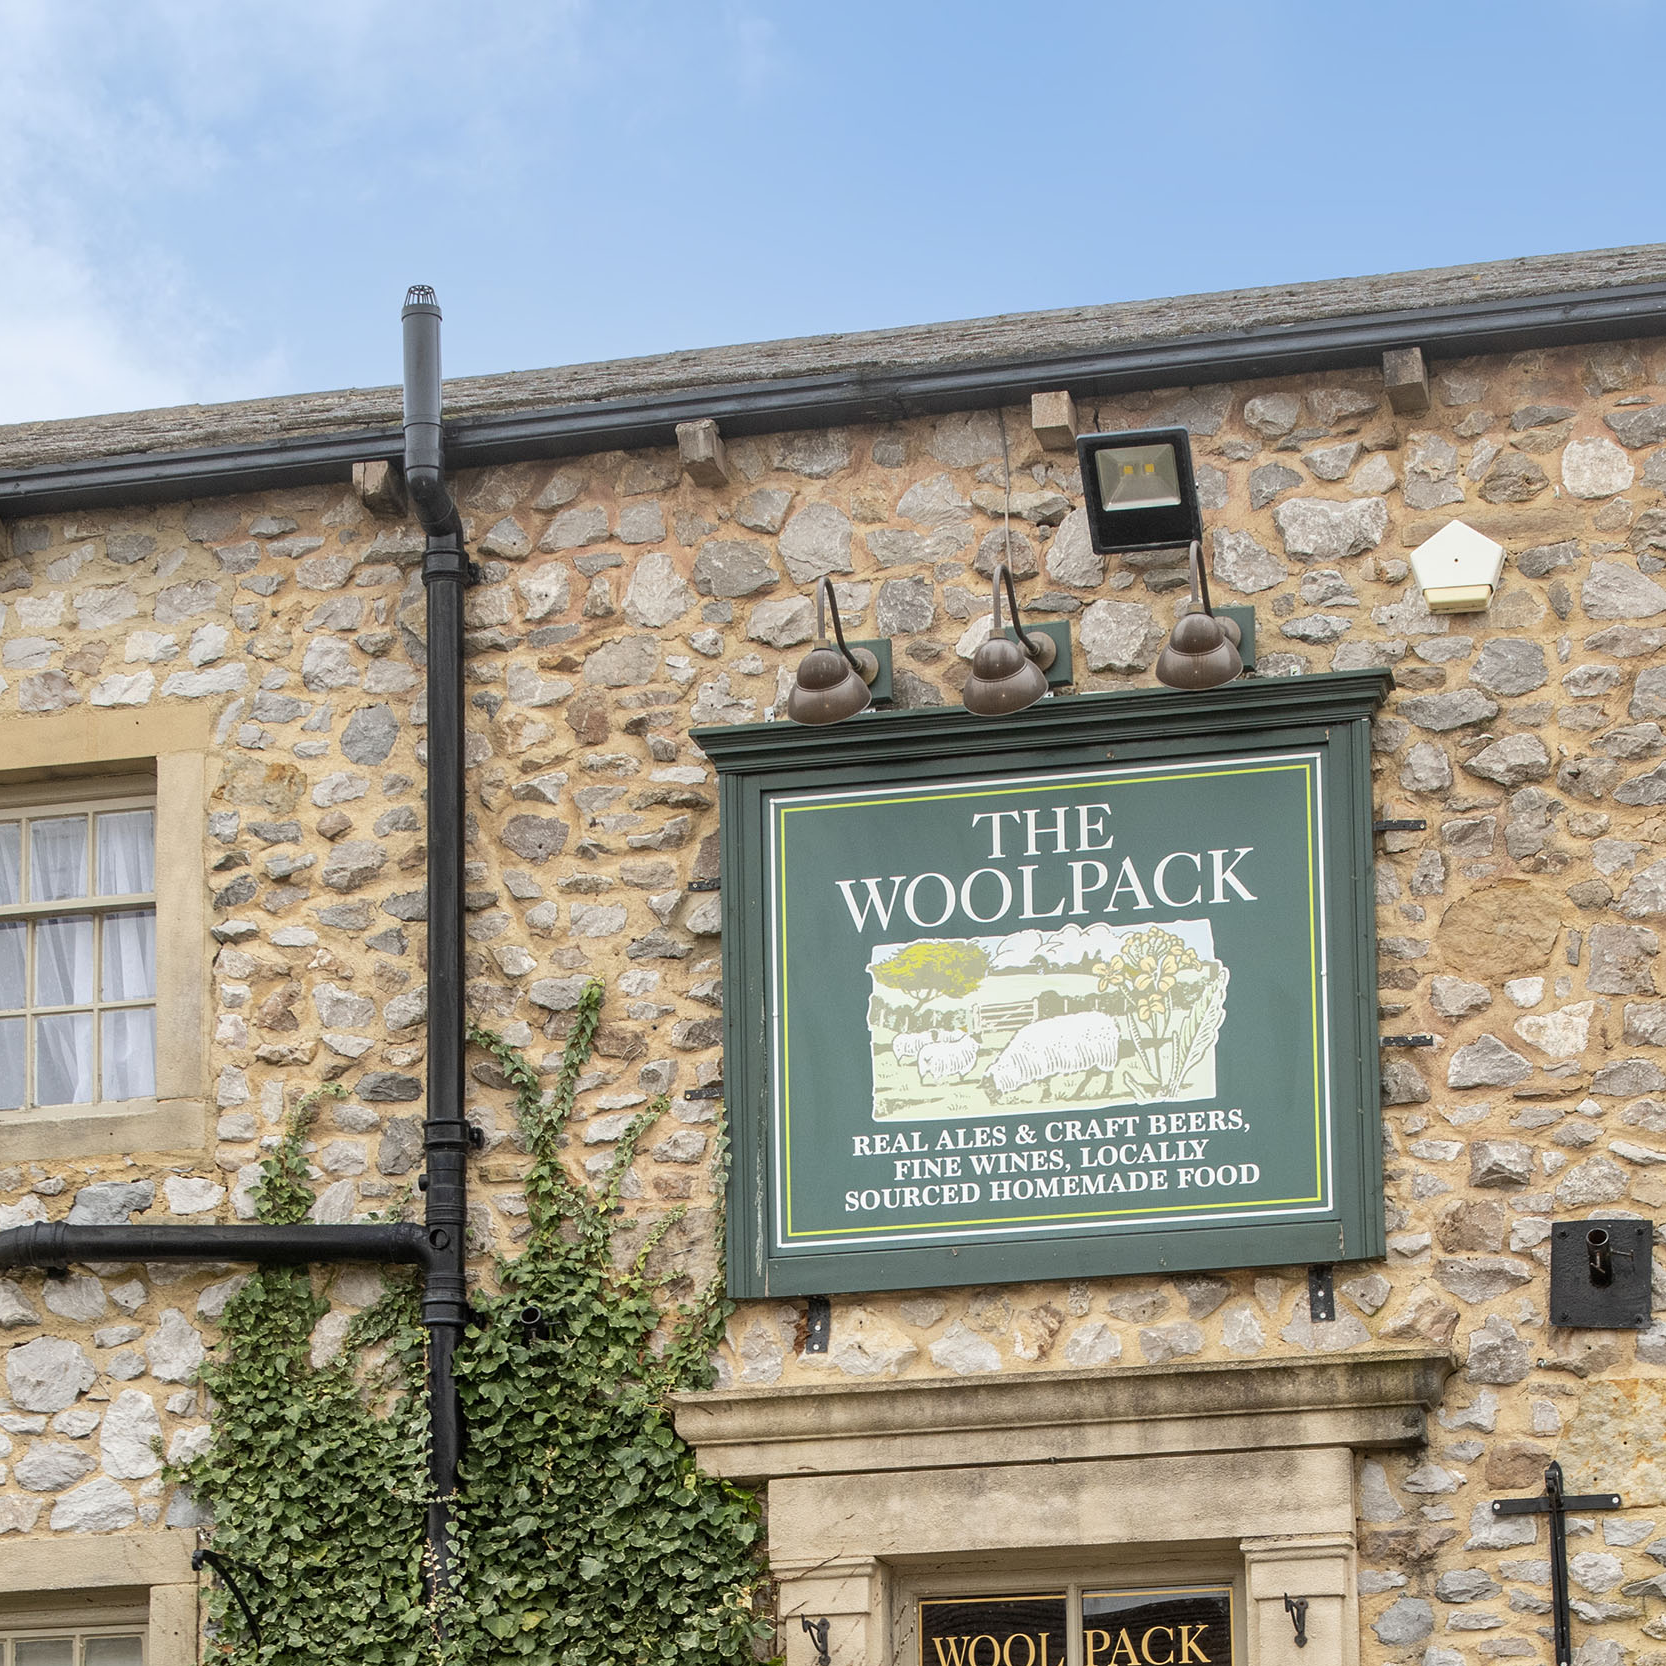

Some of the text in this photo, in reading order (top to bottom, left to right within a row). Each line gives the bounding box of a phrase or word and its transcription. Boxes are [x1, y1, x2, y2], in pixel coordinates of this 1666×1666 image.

[971, 803, 1115, 859] THE
[834, 846, 1258, 934] WOOLPACK
[851, 1107, 1252, 1158] REAL ALES & CRAFT BEERS,
[892, 1137, 1209, 1182] FINE WINES, LOCALLY
[844, 1162, 1261, 1212] SOURCED HOMEMADE FOOD
